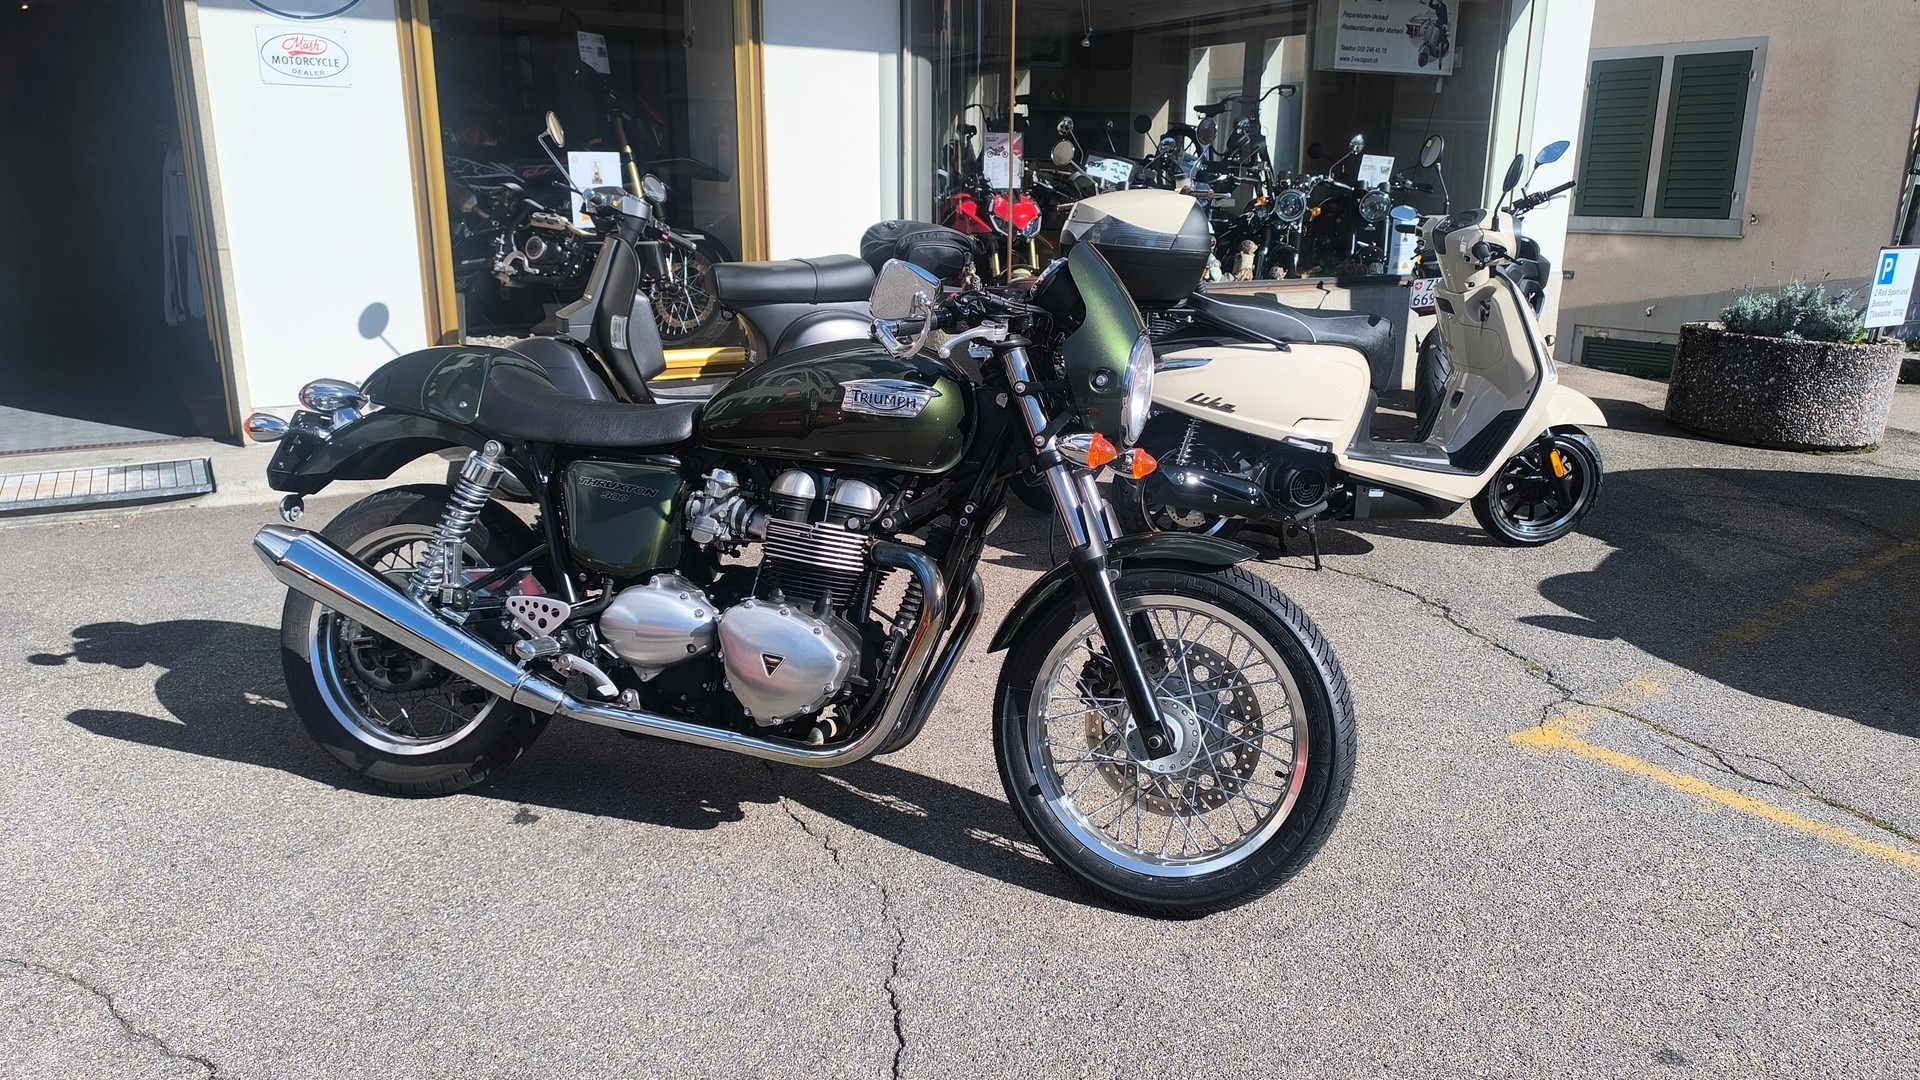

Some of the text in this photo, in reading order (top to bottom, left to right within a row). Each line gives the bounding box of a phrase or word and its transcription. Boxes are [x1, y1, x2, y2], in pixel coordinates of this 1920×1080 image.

[282, 36, 326, 54] Mash
[1341, 44, 1356, 52] Telefon
[271, 55, 340, 68] MOTORCYCLE
[291, 68, 326, 76] DEALER
[1881, 257, 1894, 281] P
[1426, 279, 1439, 291] Z
[1878, 288, 1888, 296] Rad
[1888, 288, 1900, 297] Sport
[1900, 287, 1909, 295] und
[851, 389, 917, 410] TRIUMPH
[578, 476, 659, 497] THRUXTON
[601, 491, 630, 502] 900
